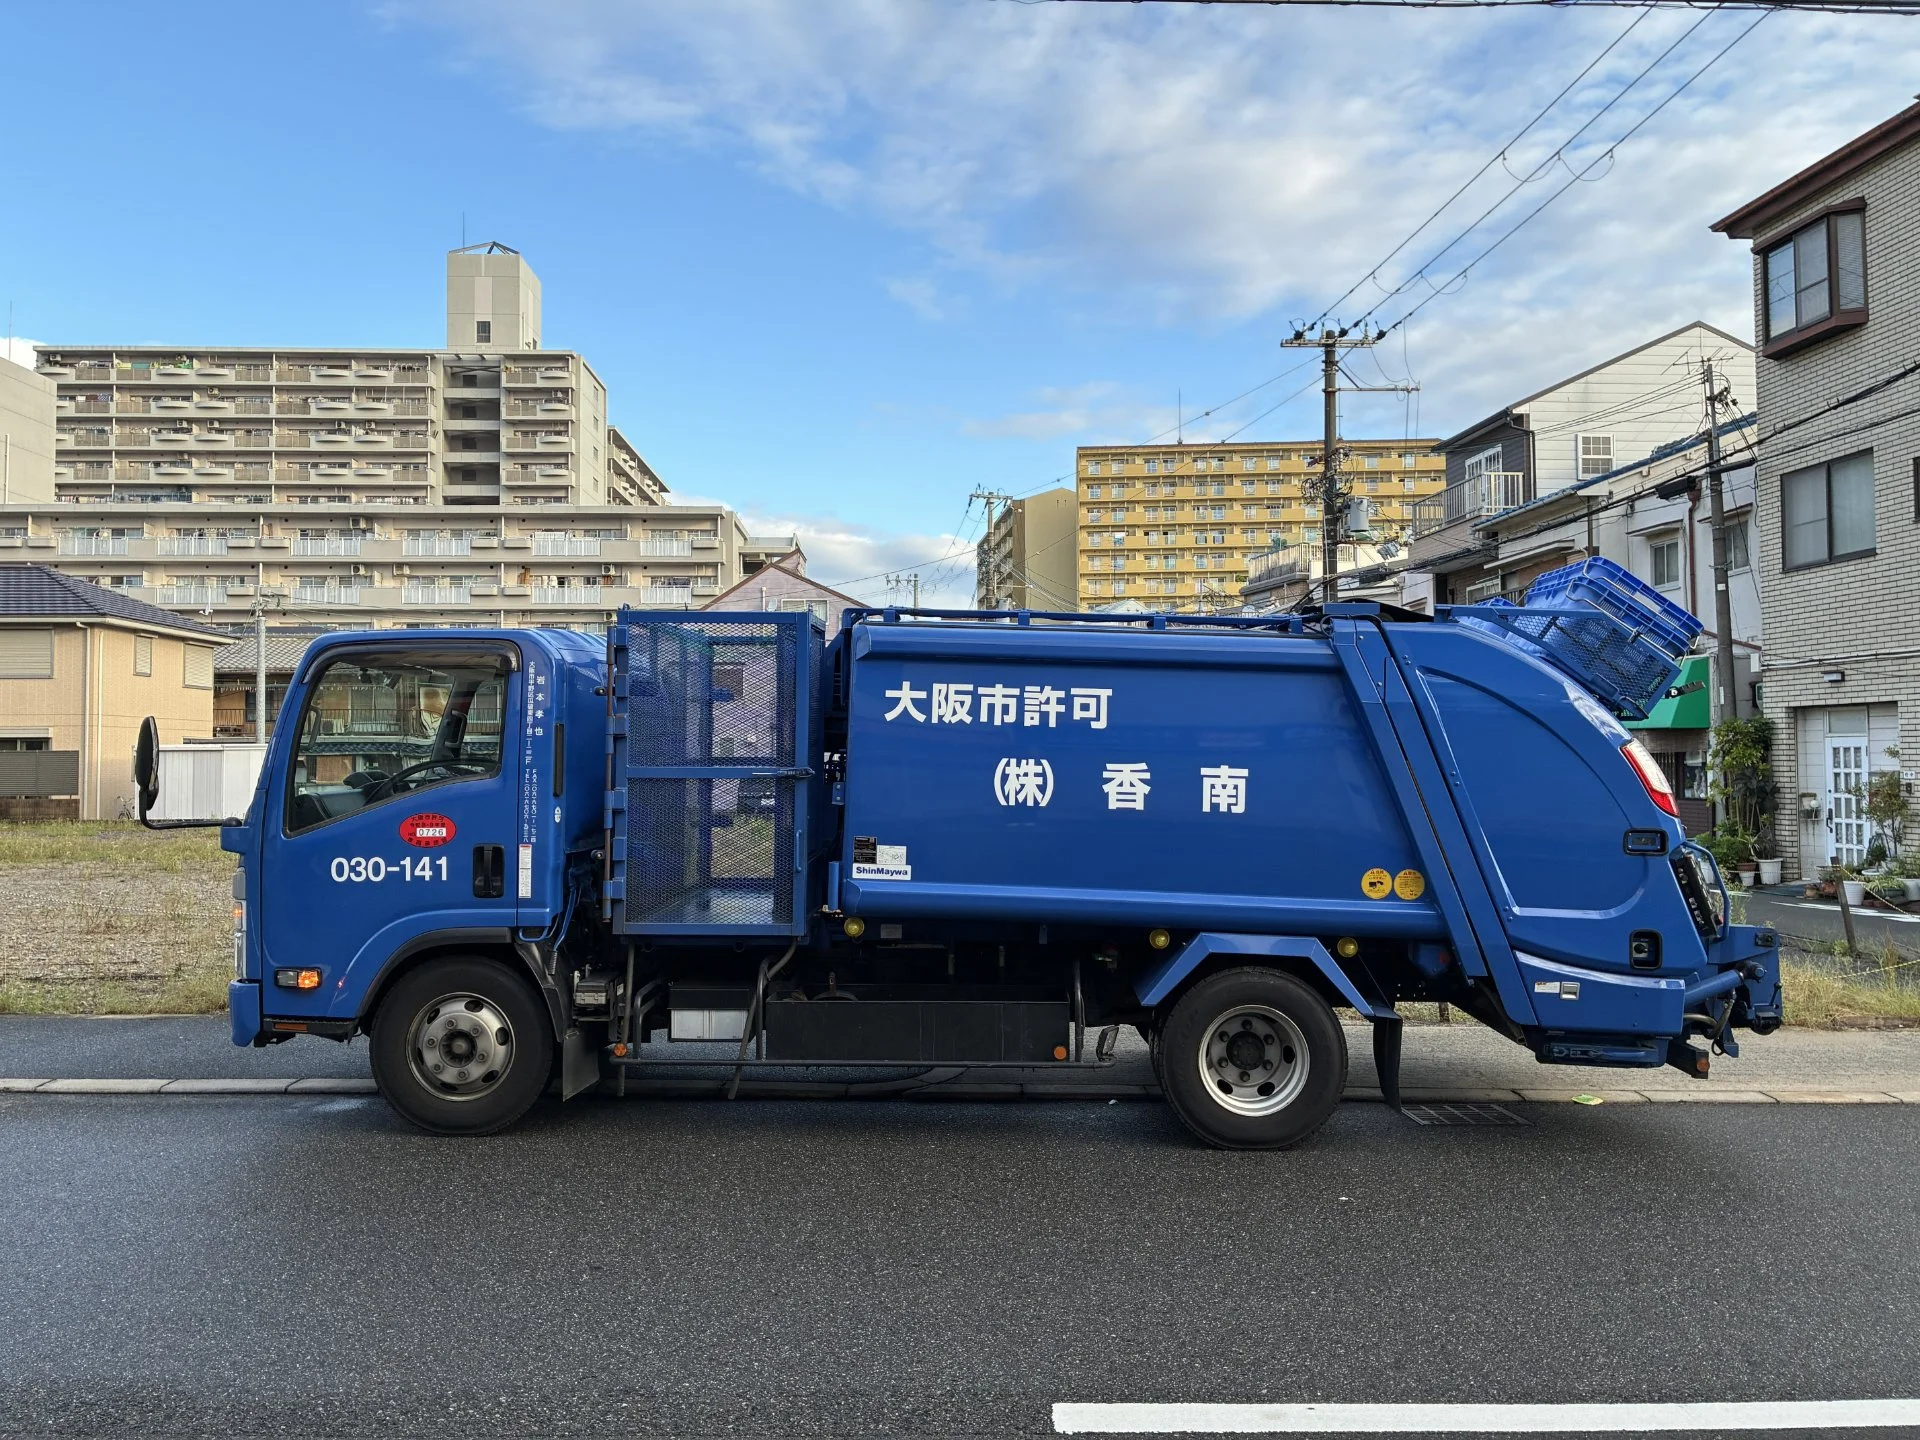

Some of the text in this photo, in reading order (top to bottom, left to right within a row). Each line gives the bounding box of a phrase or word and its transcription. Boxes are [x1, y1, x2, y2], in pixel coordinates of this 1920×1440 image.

[884, 681, 1113, 729] 大阪市許可
[418, 828, 444, 836] 0726
[331, 856, 448, 882] 030-141
[855, 866, 908, 876] ShinMaywa
